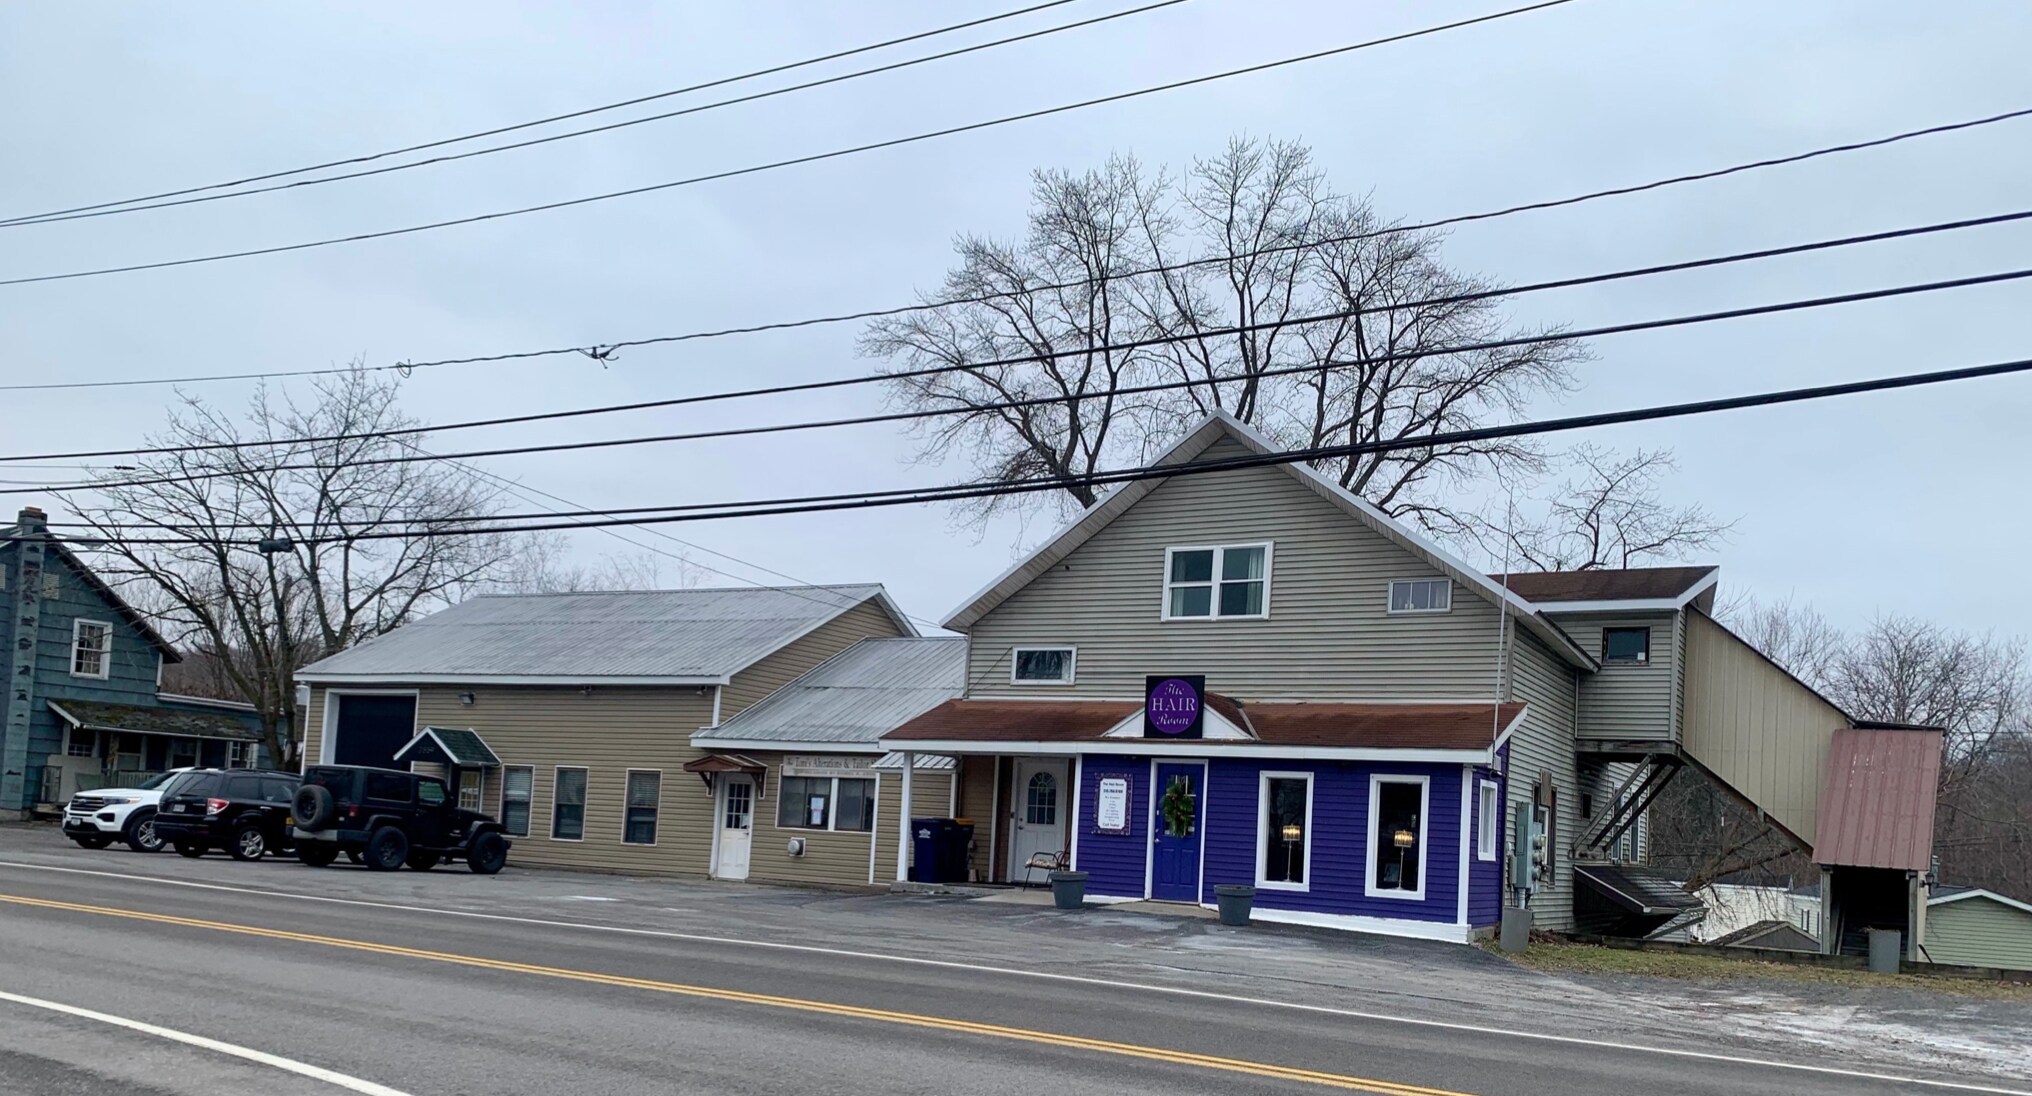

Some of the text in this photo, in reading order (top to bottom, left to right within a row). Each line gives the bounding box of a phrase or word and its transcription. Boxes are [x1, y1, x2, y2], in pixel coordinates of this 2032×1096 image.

[1164, 683, 1185, 695] The
[1151, 697, 1196, 712] HAIR
[1156, 713, 1190, 725] Room
[844, 758, 850, 769] &
